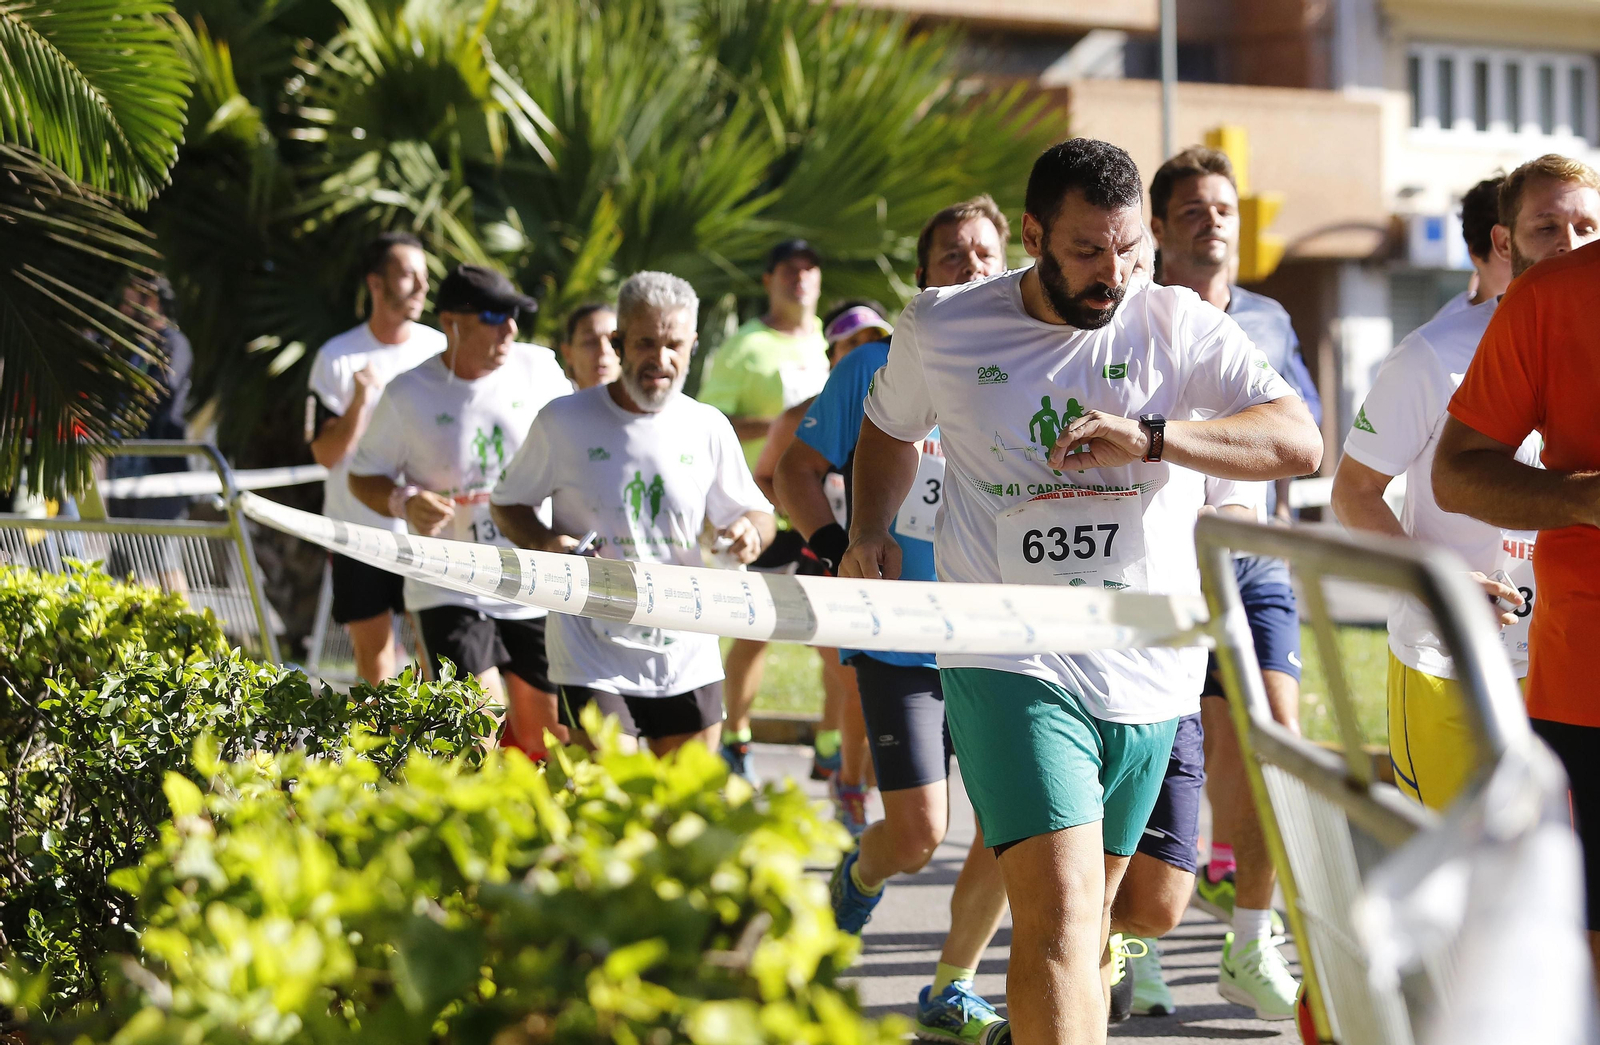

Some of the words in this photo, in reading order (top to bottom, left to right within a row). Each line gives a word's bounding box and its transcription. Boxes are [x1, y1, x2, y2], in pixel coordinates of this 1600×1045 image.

[978, 366, 1009, 381] 2020
[923, 479, 940, 505] 3
[1006, 483, 1020, 496] 41
[1022, 523, 1120, 564] 6357
